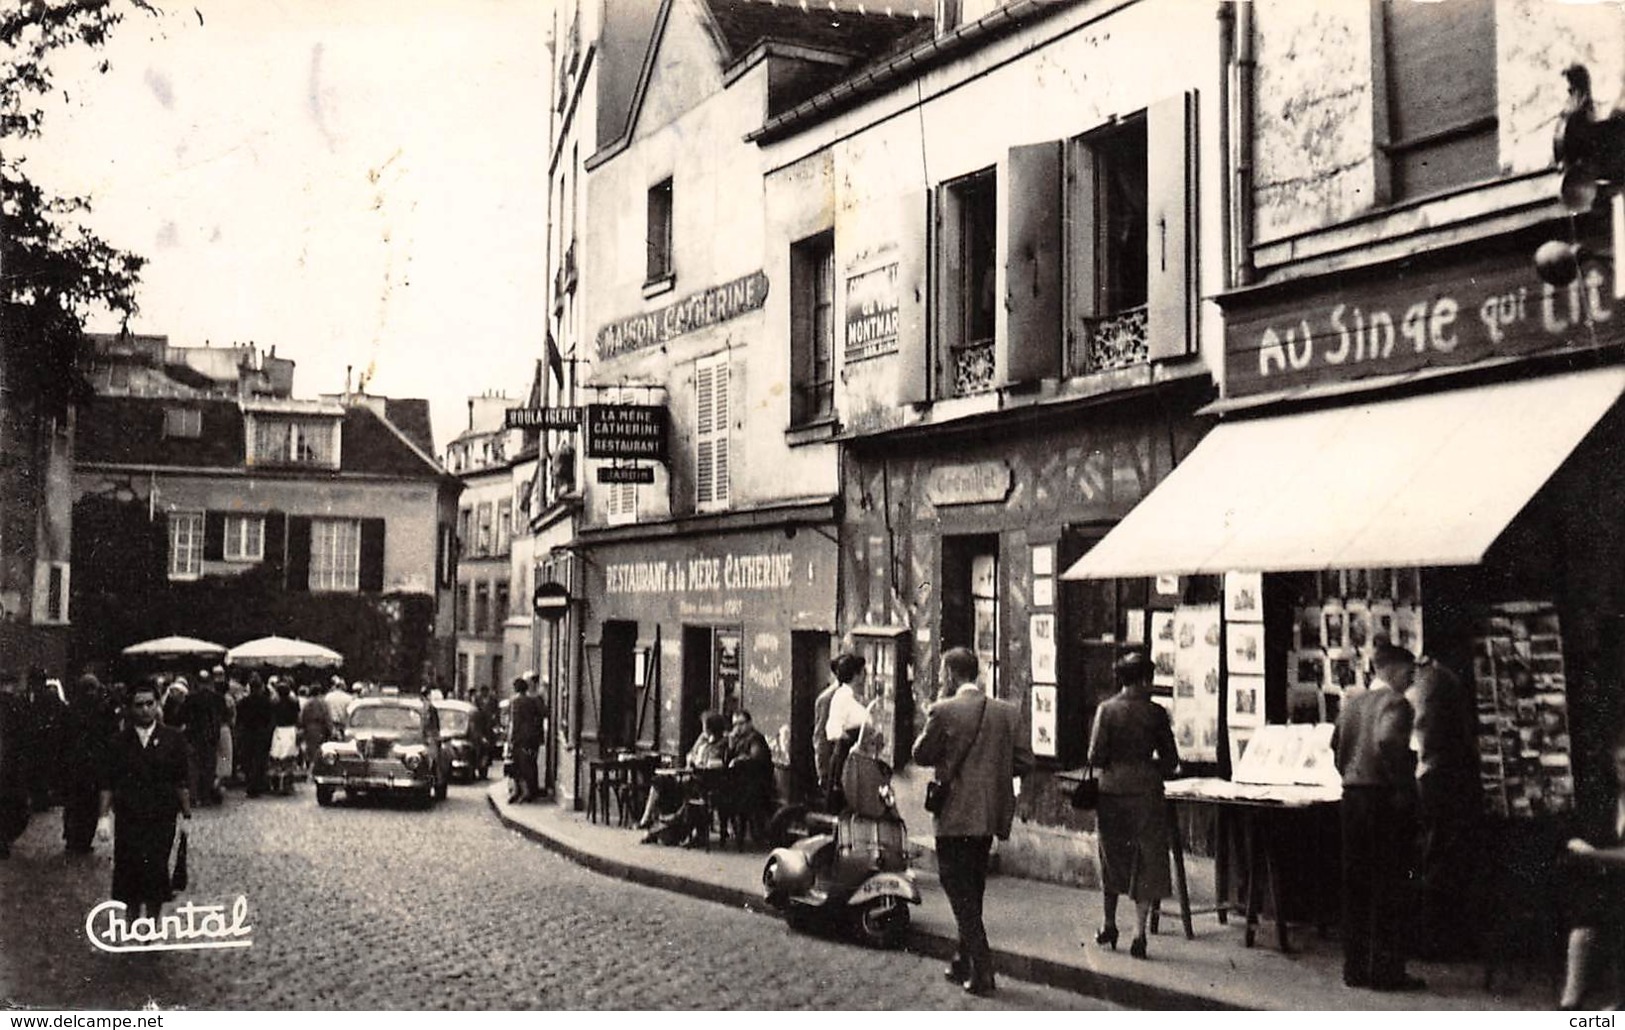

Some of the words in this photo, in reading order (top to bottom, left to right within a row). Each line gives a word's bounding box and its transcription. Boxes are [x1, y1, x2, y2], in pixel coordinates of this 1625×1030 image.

[604, 314, 658, 350] MAISON
[663, 279, 756, 340] CATHERINE
[1259, 320, 1312, 376] AU
[1480, 287, 1527, 343] qui
[594, 421, 660, 435] CATHERINE
[601, 409, 615, 420] LA
[594, 438, 660, 451] RESTAURANT
[606, 561, 667, 593] RESTAURANT
[676, 560, 685, 591] la
[724, 553, 792, 590] CATHERINE
